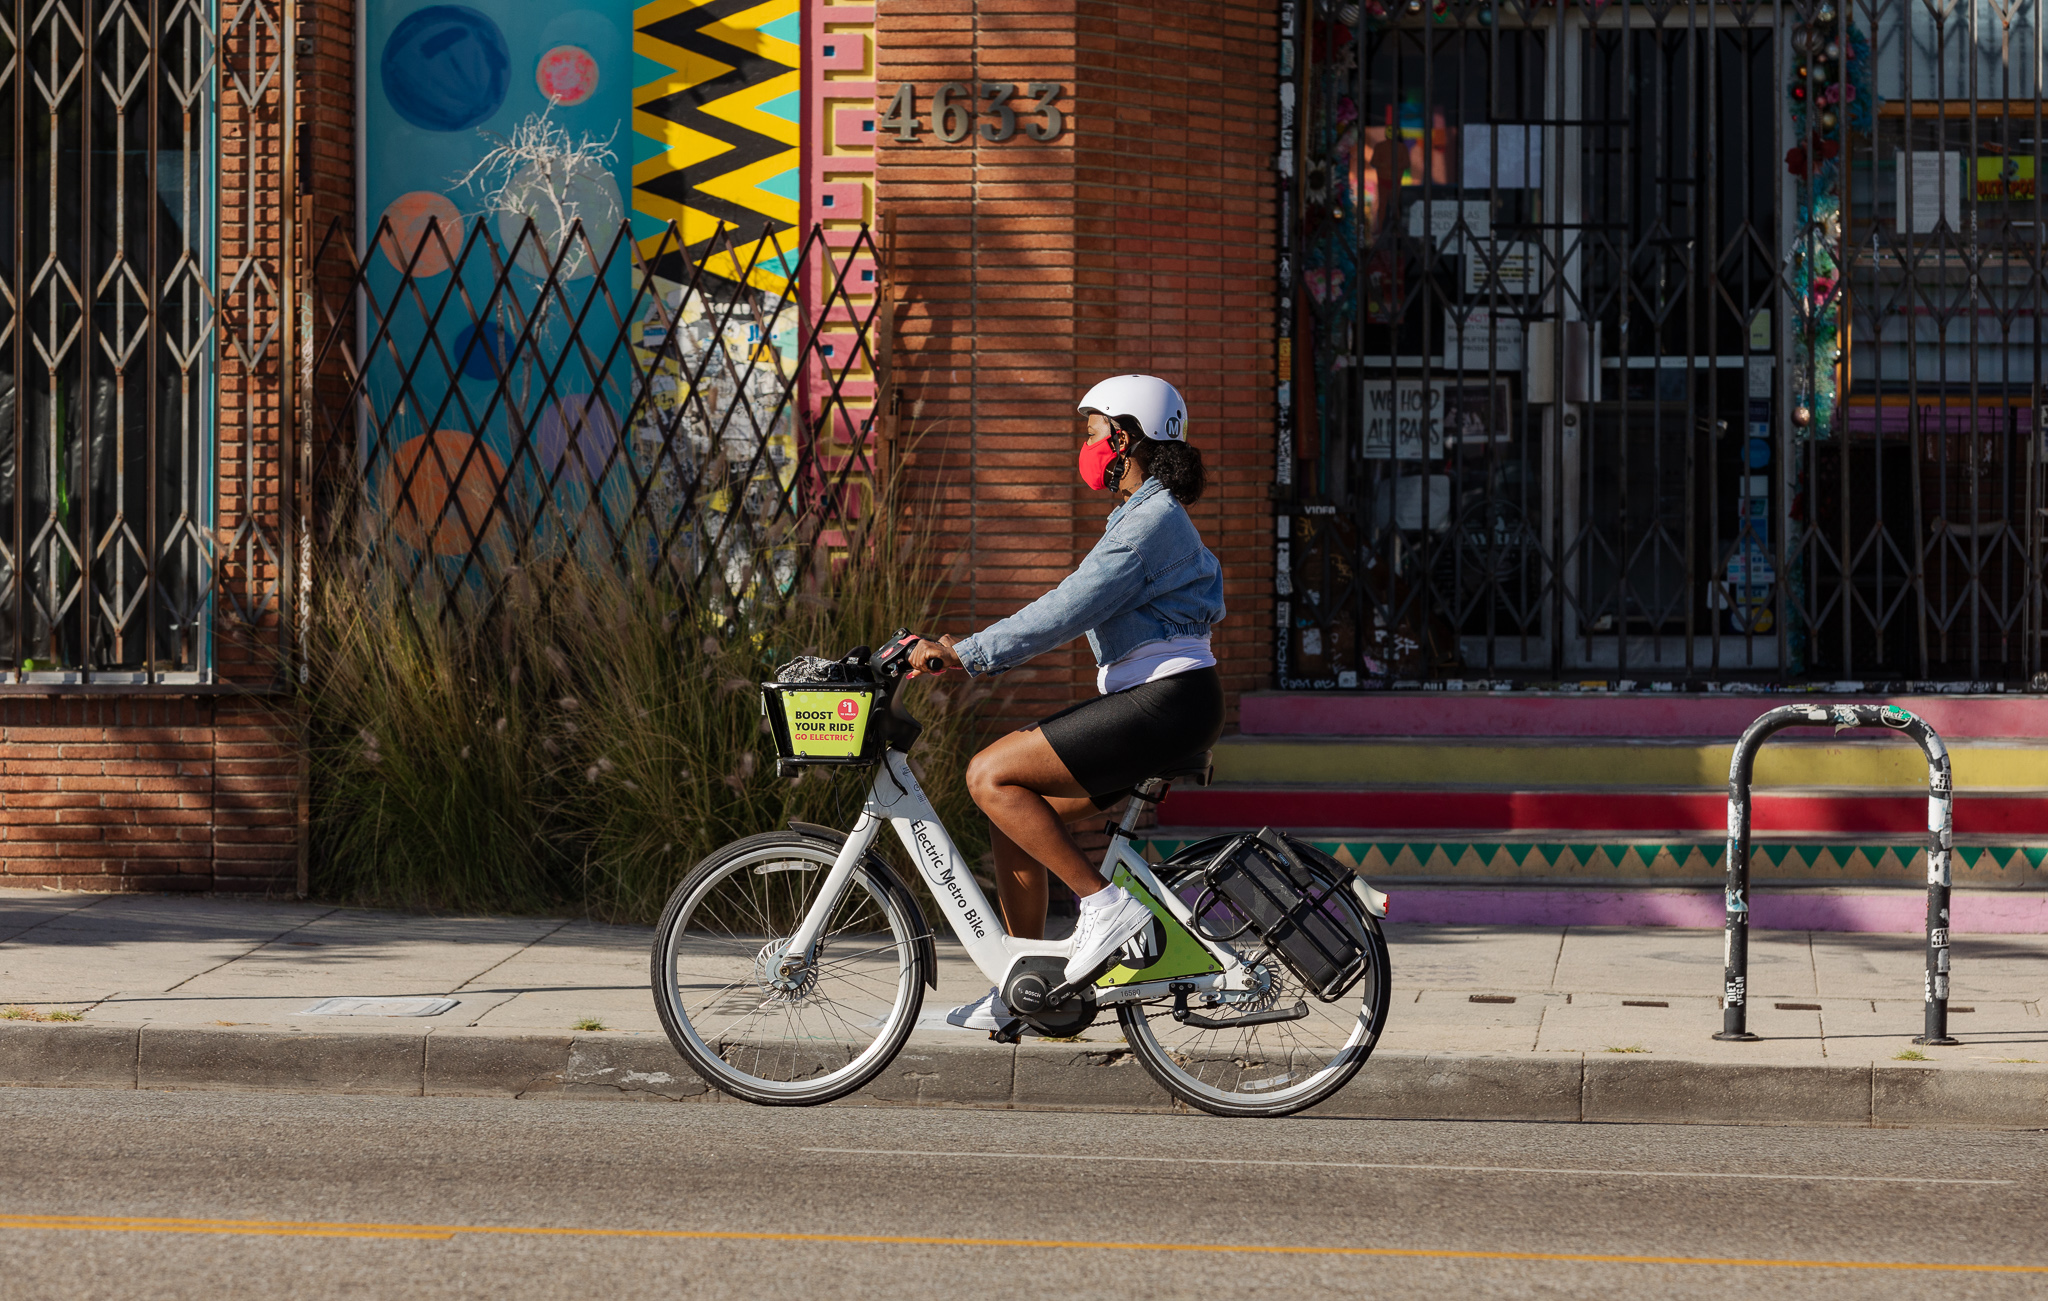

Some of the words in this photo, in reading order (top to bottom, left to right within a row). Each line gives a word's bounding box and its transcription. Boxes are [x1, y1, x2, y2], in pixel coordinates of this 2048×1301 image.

[881, 83, 1062, 142] 4633
[1401, 389, 1440, 412] HOD
[1168, 421, 1179, 436] M
[1399, 418, 1440, 446] BAS
[842, 701, 852, 713] $1
[795, 711, 834, 720] BOOST
[795, 722, 826, 731] YOUR
[829, 723, 855, 732] RIDE
[795, 733, 808, 741] GO
[911, 819, 944, 869] Electric
[939, 868, 967, 909] Metro
[963, 909, 985, 939] Bike
[1024, 989, 1042, 998] BOSCH
[1120, 989, 1141, 998] 16580
[1726, 981, 1737, 1002] DIET
[1735, 975, 1746, 1006] VEGAN
